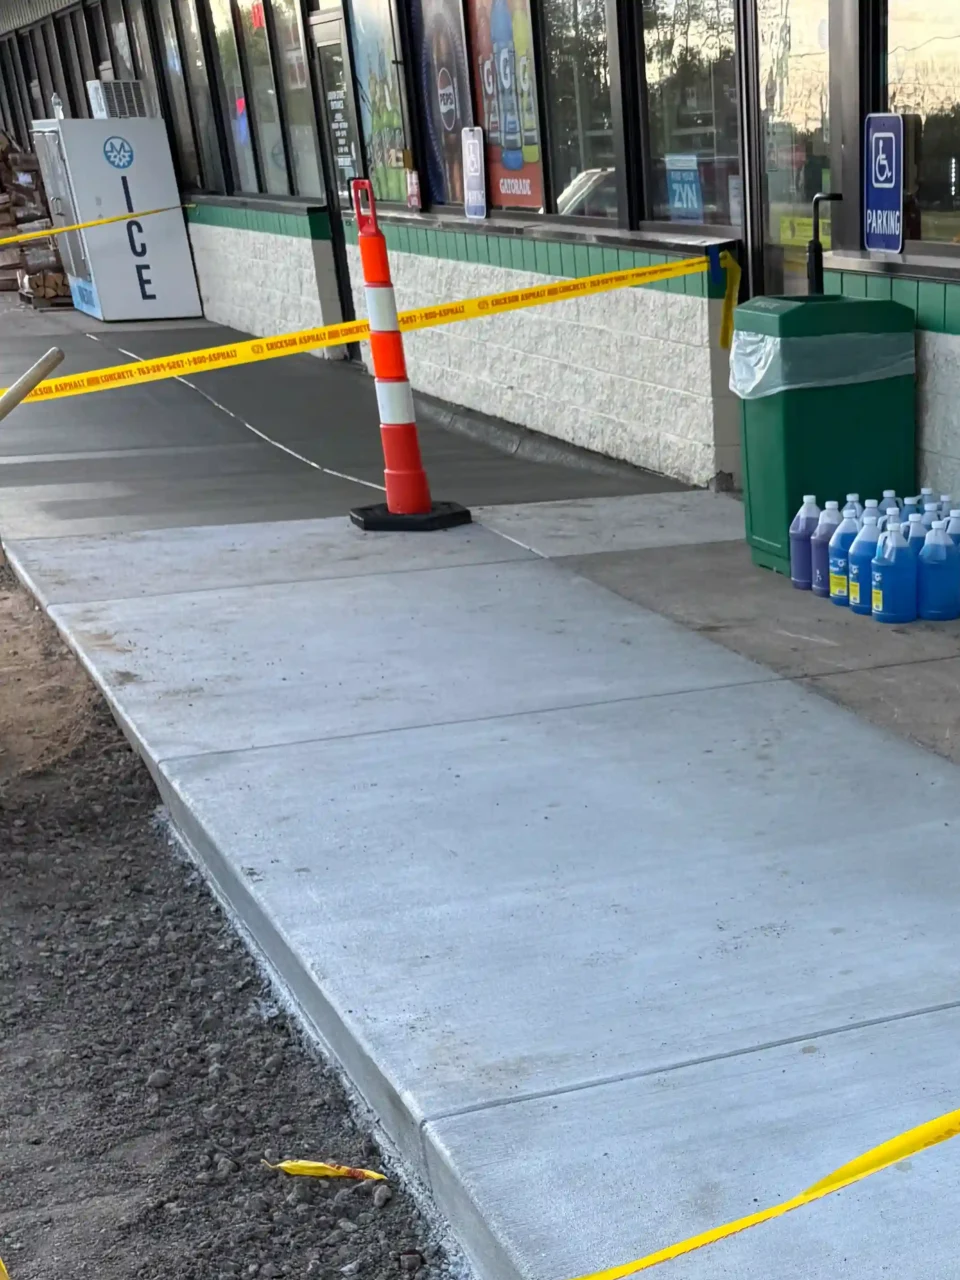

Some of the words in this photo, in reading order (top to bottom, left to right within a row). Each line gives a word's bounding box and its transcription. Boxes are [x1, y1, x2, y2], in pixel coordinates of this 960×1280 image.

[500, 177, 532, 196] GATORADE
[672, 182, 699, 210] ZYN
[866, 209, 900, 236] PARKING
[121, 175, 157, 300] ICE
[266, 337, 298, 350] ERICKSON
[299, 332, 327, 346] ASPHALT
[55, 379, 85, 393] ASPHALT
[100, 369, 134, 384] CONCRETE
